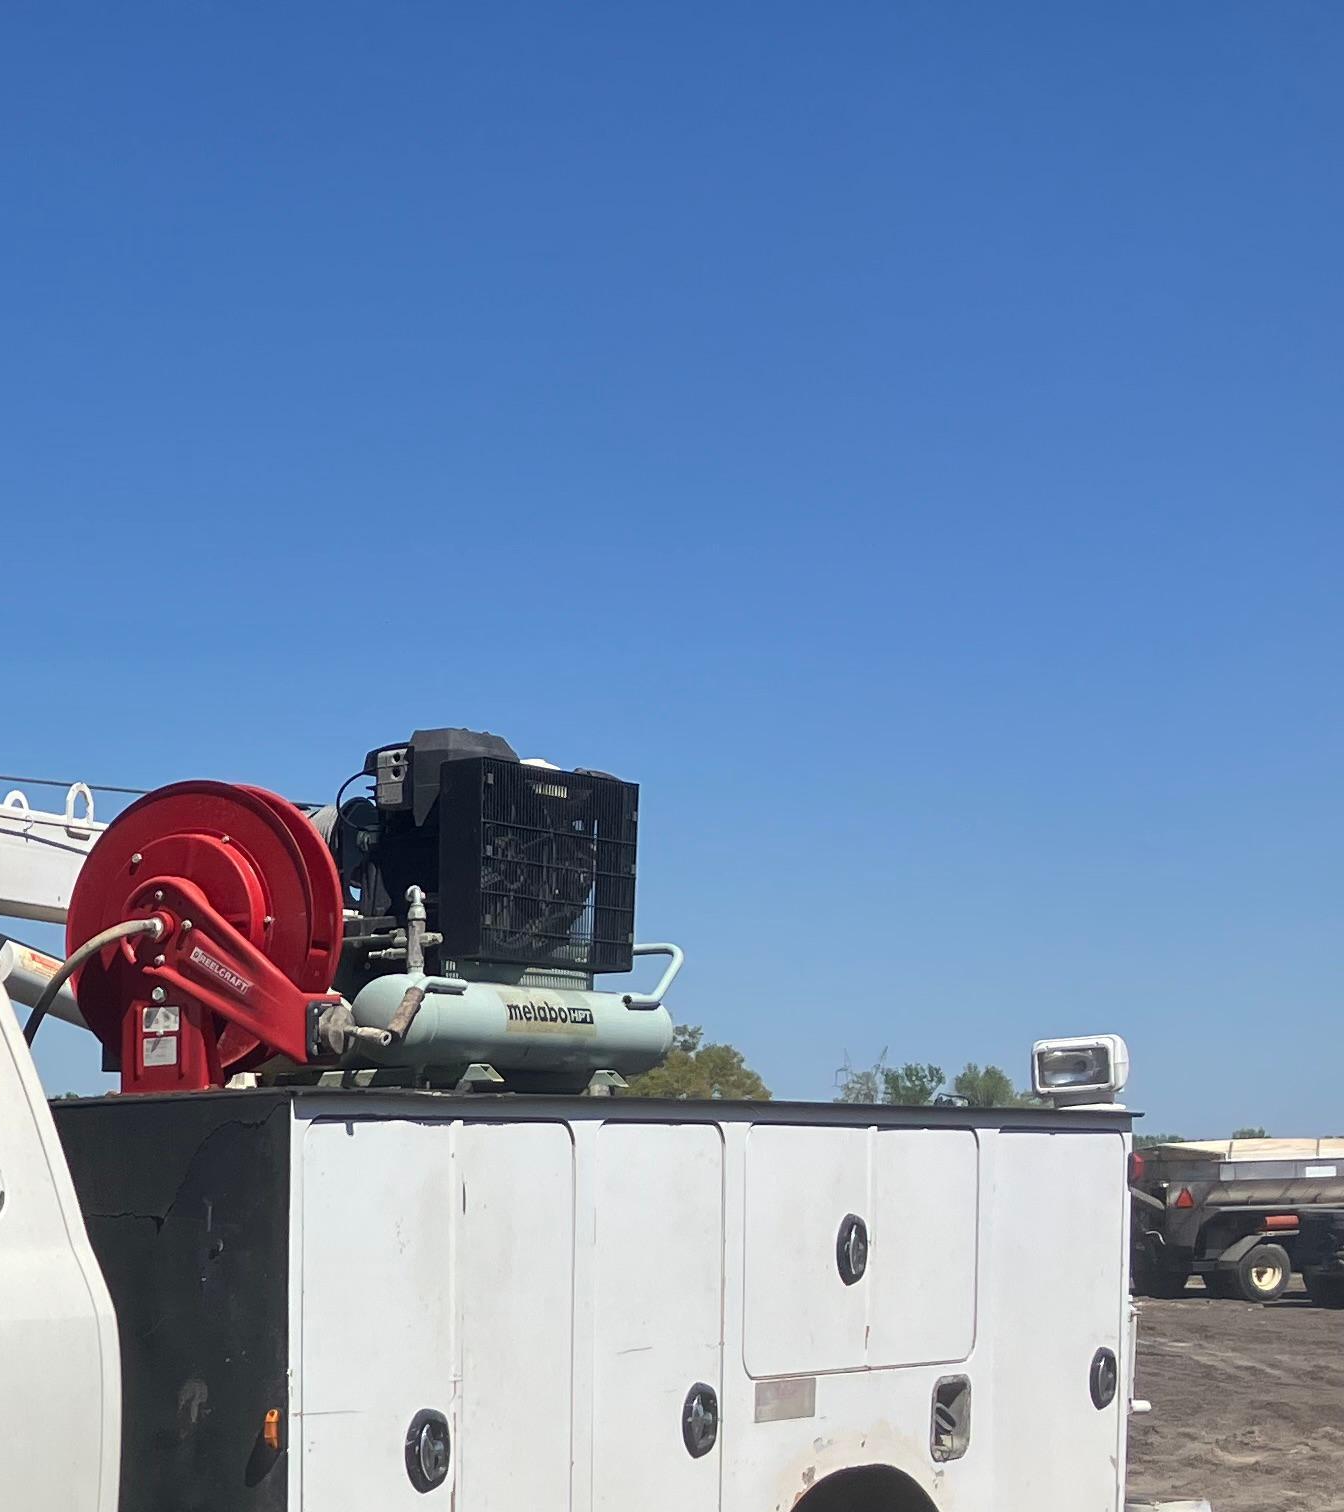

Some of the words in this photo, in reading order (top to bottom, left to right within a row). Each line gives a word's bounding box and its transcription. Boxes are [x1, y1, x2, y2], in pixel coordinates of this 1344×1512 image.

[199, 953, 249, 992] REELCRAFT
[506, 1001, 568, 1024] metabo
[571, 1010, 591, 1022] HPT
